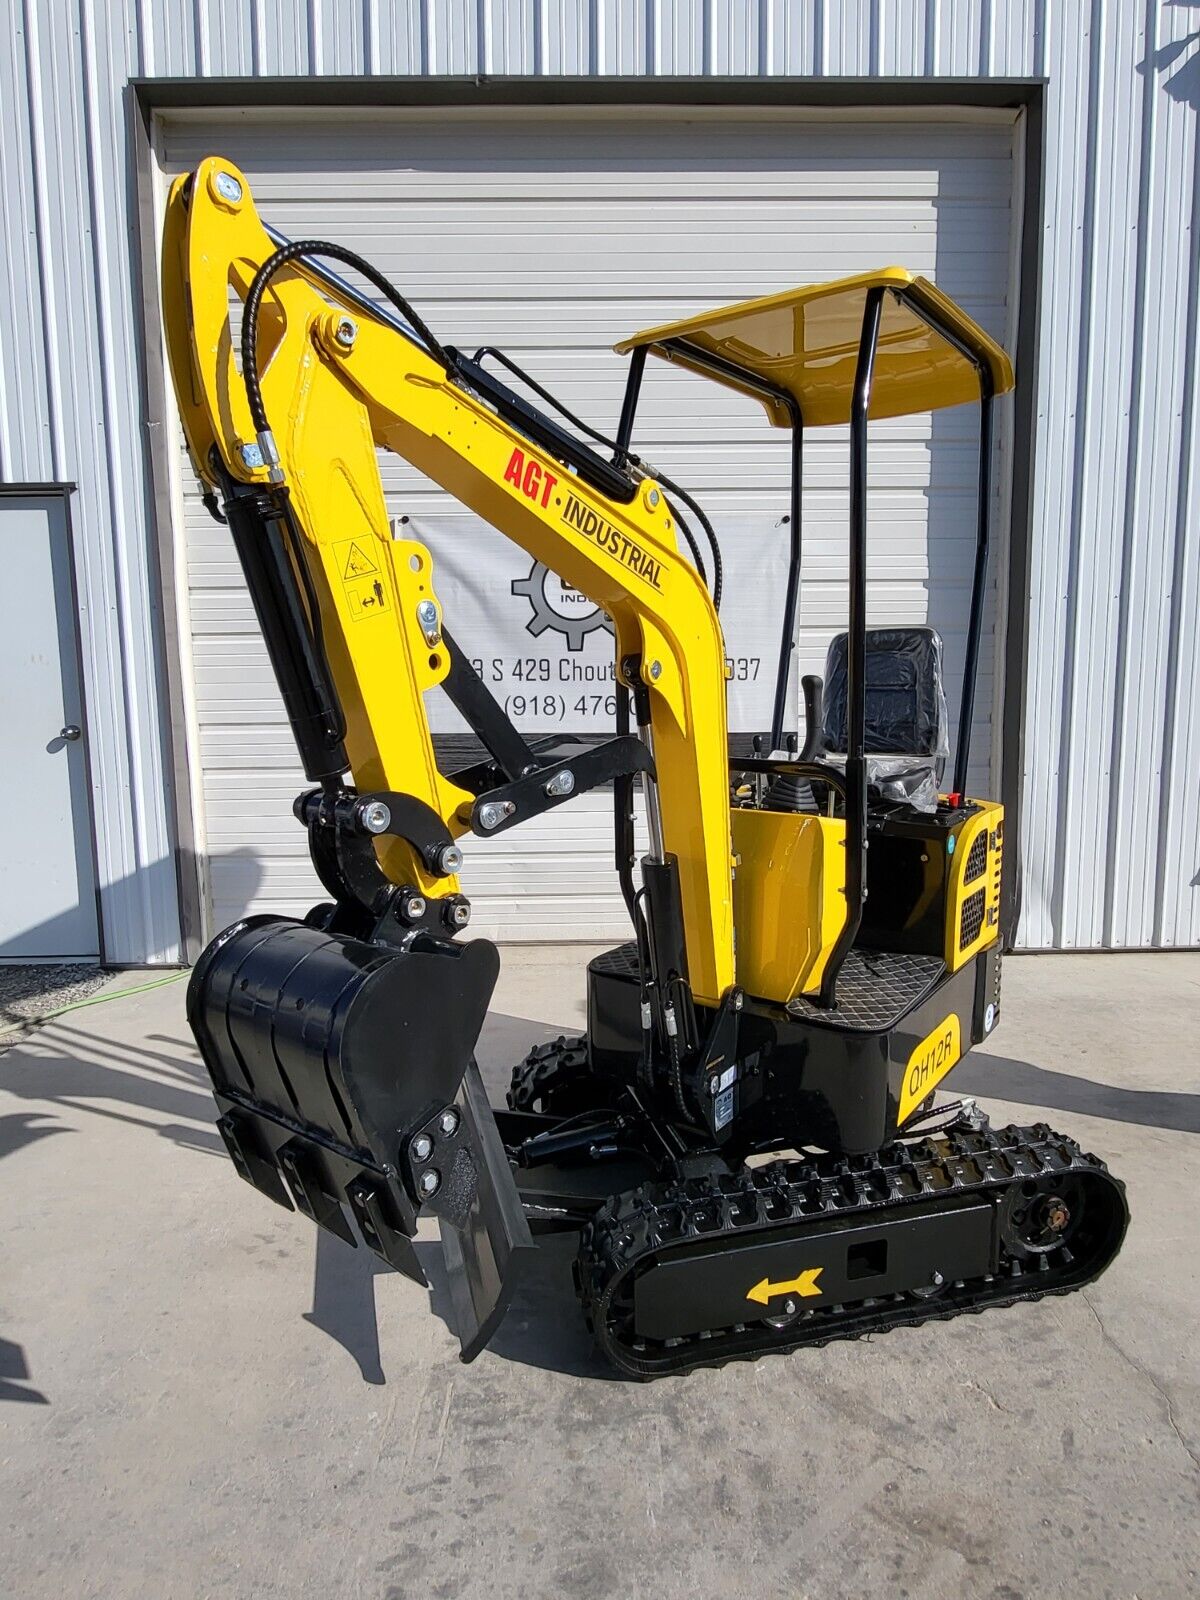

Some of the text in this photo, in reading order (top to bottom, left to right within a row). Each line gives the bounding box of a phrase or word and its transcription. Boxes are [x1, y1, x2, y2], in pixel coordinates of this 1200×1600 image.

[503, 447, 661, 588] AGT INDUSTRIAL
[561, 594, 591, 603] IND
[492, 658, 503, 681] S
[512, 658, 550, 681] 429
[505, 695, 566, 721] (918)
[909, 1030, 952, 1096] QH12R
